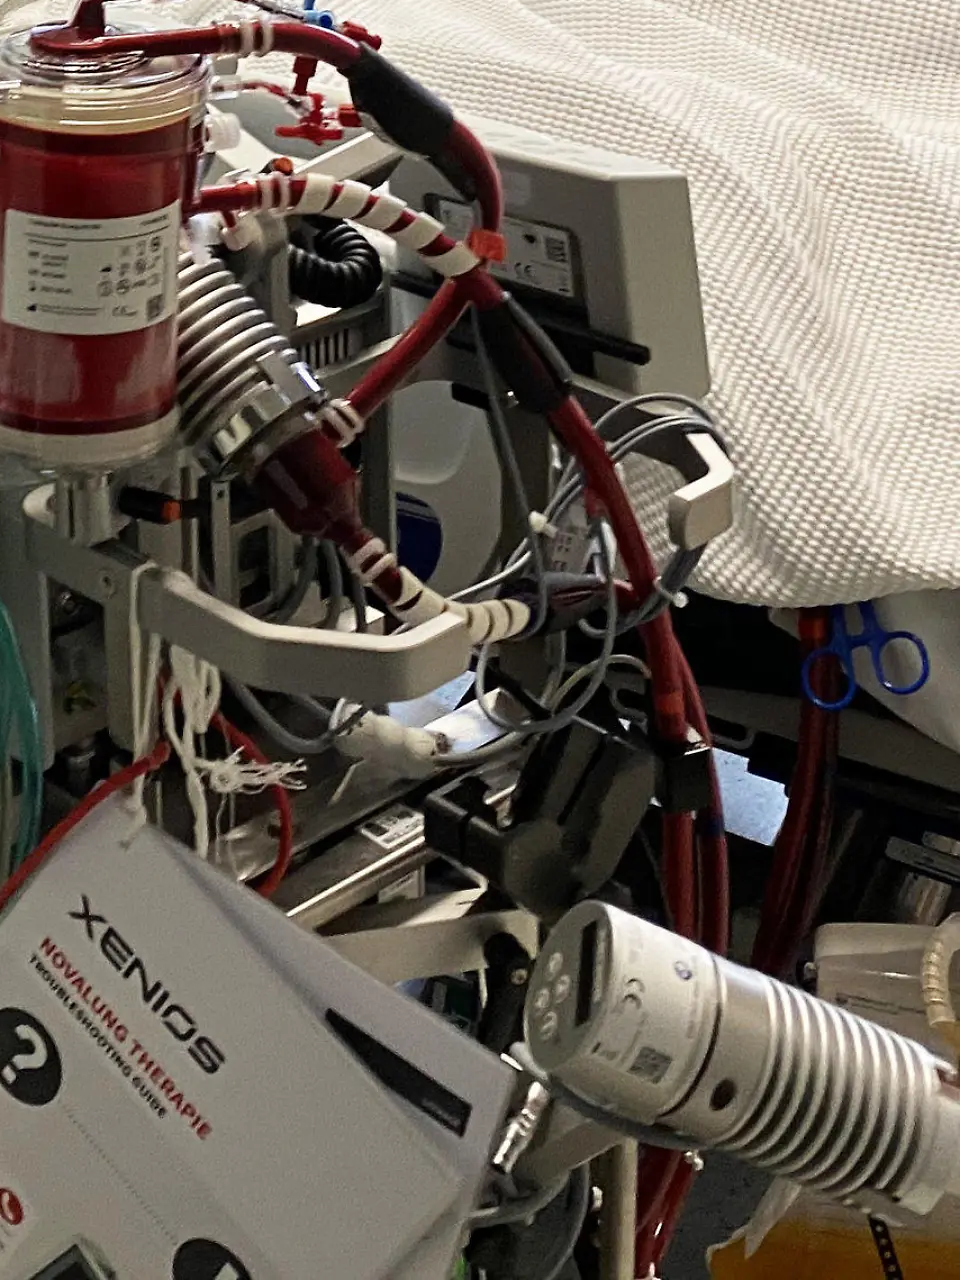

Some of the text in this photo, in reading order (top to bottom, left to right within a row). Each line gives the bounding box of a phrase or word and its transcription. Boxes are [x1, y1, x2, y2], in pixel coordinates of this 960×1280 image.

[27, 952, 168, 1120] TROUBLESHOOTING GUIDE
[39, 935, 213, 1141] NOVALUNG THERAPIE
[67, 893, 227, 1075] XENIOS
